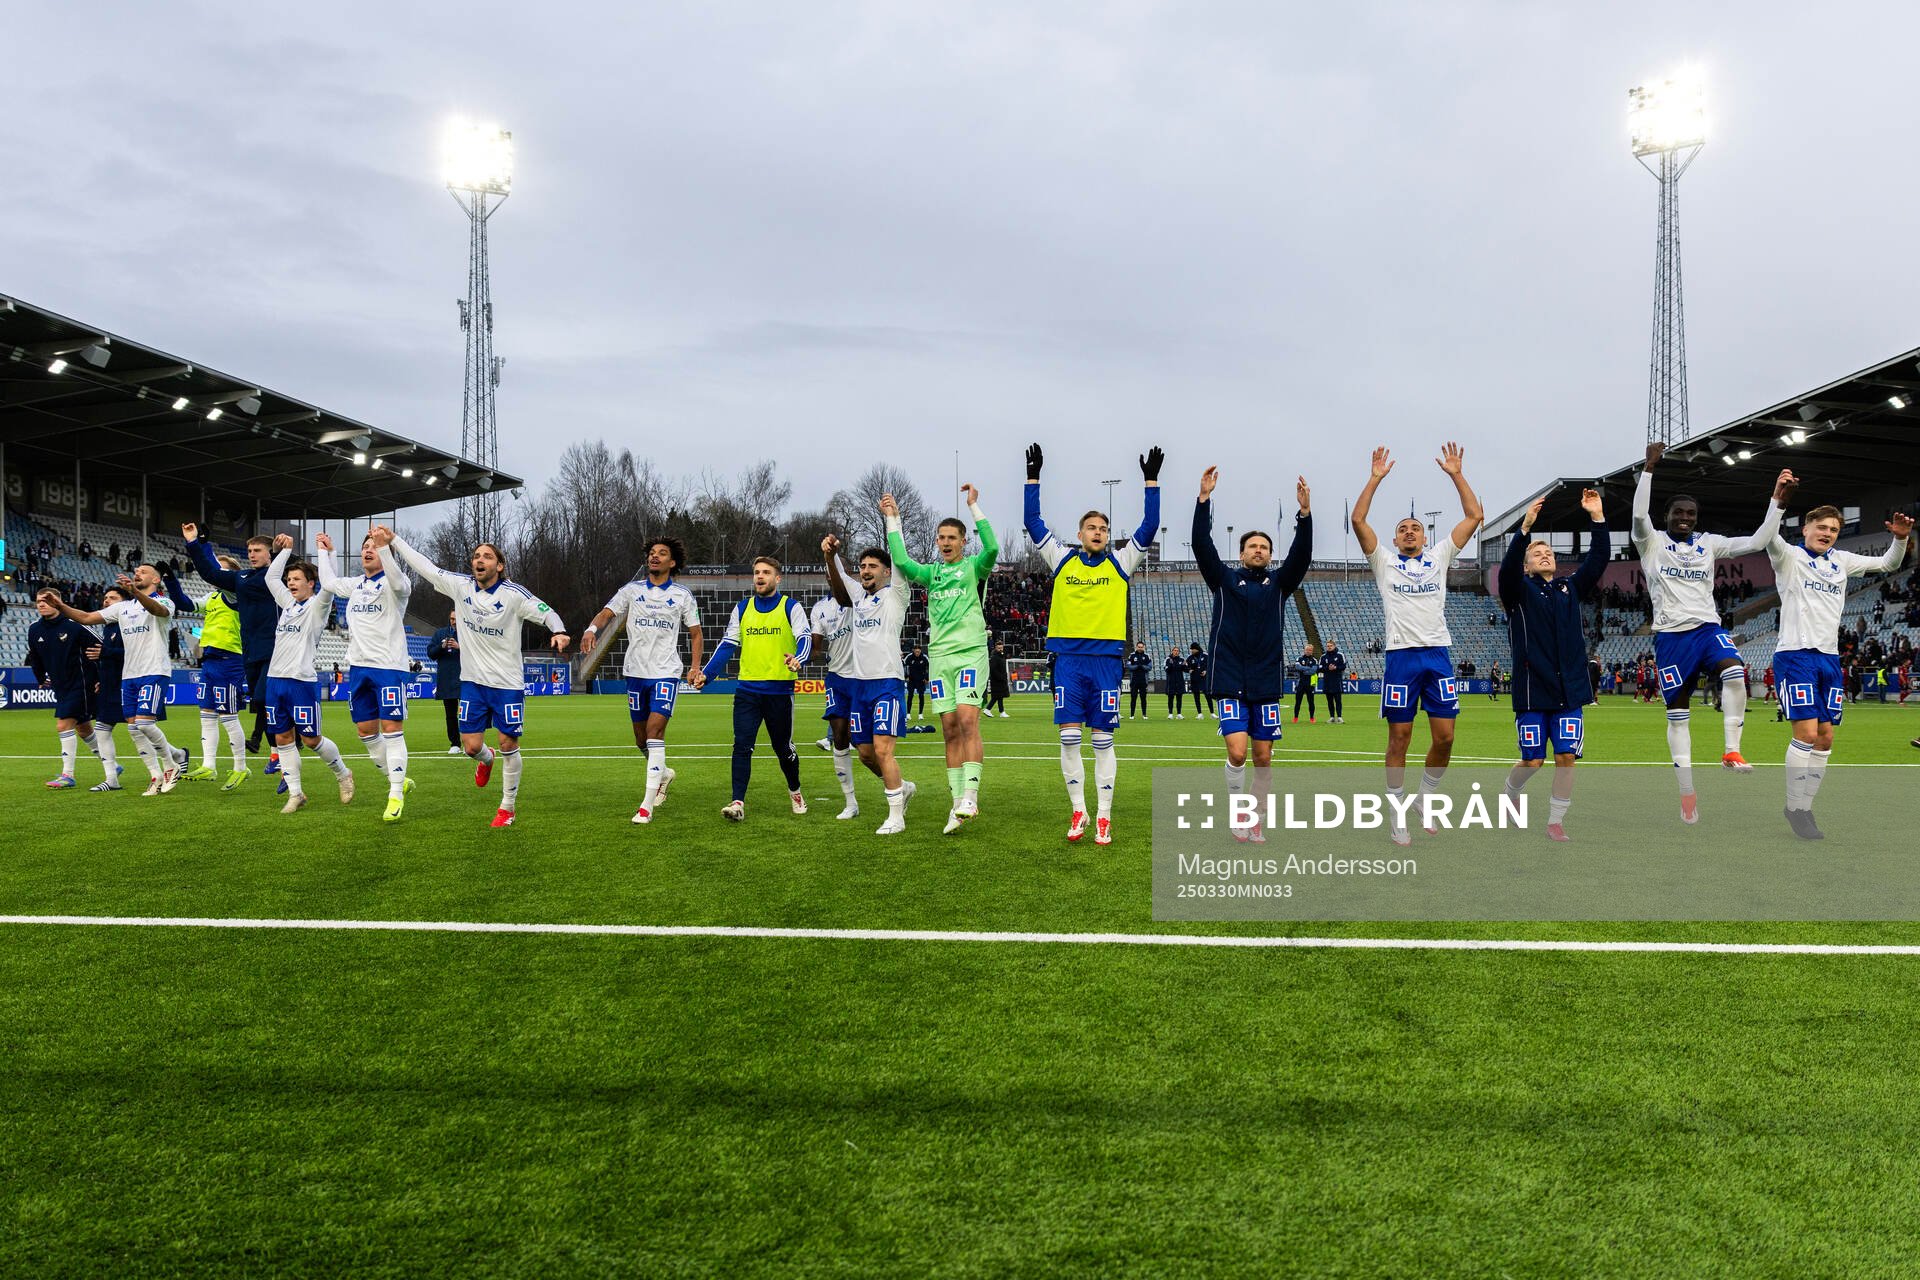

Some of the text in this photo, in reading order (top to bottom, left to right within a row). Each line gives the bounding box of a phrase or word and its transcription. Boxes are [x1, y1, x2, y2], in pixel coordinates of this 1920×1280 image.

[40, 480, 88, 509] 1989
[1660, 565, 1710, 579] HOLMEN
[1714, 563, 1744, 579] AN
[1066, 576, 1110, 585] stadium
[1393, 582, 1440, 594] HOLMEN
[634, 618, 675, 630] HOLMEN
[746, 626, 782, 636] stadium
[1016, 680, 1052, 692] DAH
